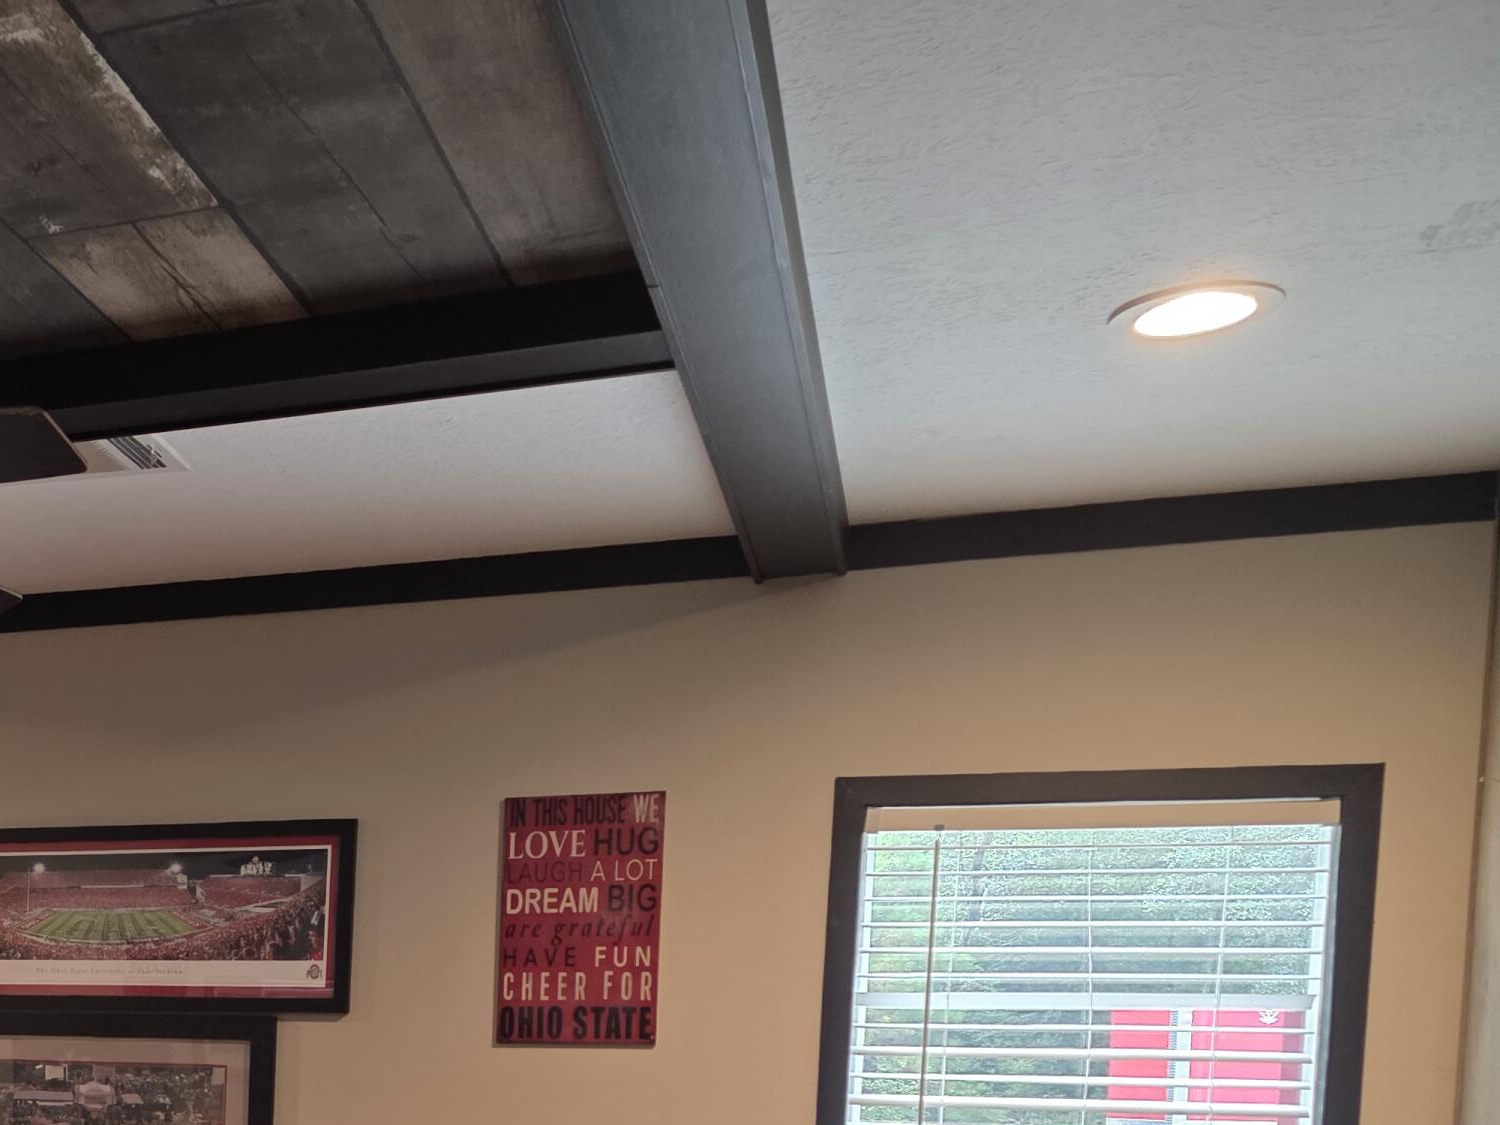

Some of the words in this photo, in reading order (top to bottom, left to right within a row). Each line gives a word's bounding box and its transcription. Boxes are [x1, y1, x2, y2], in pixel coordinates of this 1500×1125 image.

[510, 798, 526, 828] IN
[533, 798, 567, 826] THIS
[574, 795, 627, 825] HOUSE
[633, 793, 660, 824] WE
[508, 830, 586, 859] LOVE
[594, 827, 659, 856] HUG
[506, 861, 583, 884] LAUGH
[590, 860, 606, 881] A
[615, 859, 658, 881] LOT
[506, 887, 599, 915] DREAM
[607, 883, 657, 913] BIG
[504, 922, 548, 938] are
[551, 914, 655, 946] grateful
[504, 947, 576, 968] HAVE
[594, 946, 651, 968] FUN
[504, 972, 586, 1001] CHEER
[603, 971, 653, 1001] FOR
[500, 1006, 563, 1040] OHIO
[572, 1006, 651, 1040] STATE
